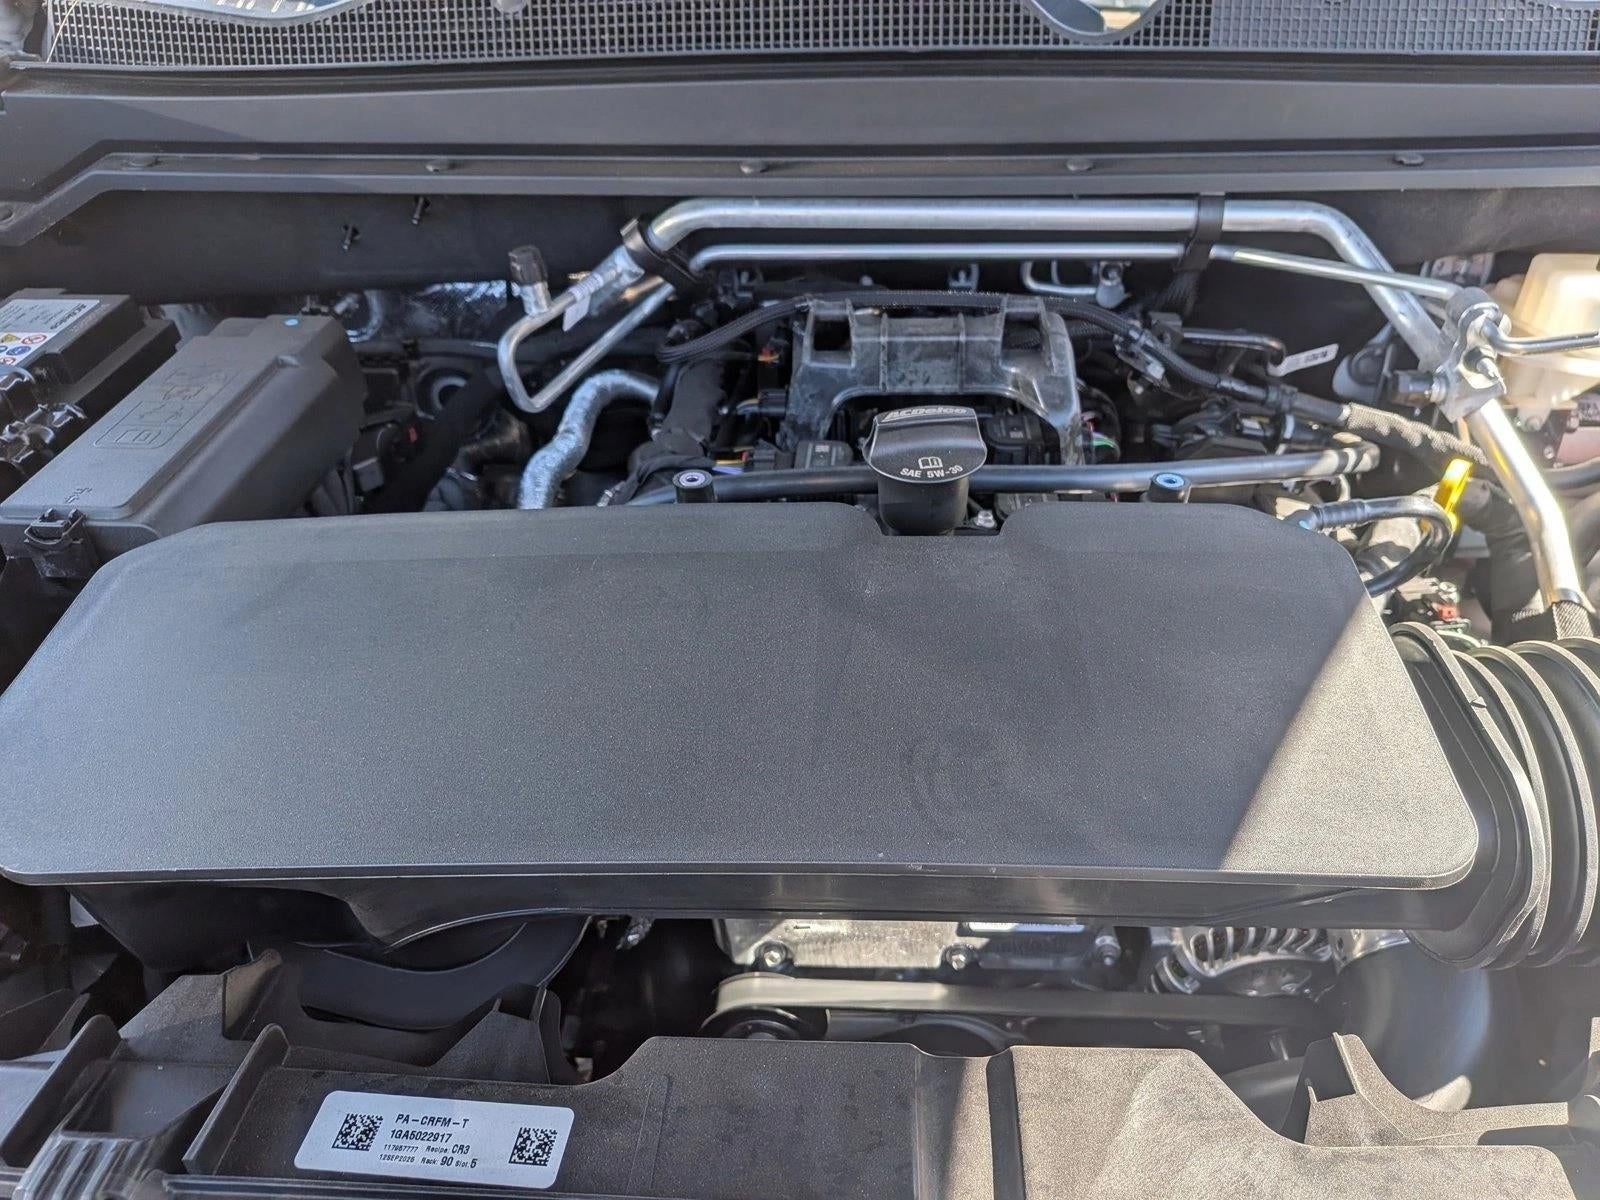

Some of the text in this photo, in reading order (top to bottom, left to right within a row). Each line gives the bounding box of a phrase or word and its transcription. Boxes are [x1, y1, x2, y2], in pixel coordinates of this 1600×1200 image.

[900, 465, 964, 478] SAE 5W-30
[451, 1143, 471, 1155] CR3
[440, 1155, 454, 1167] 90
